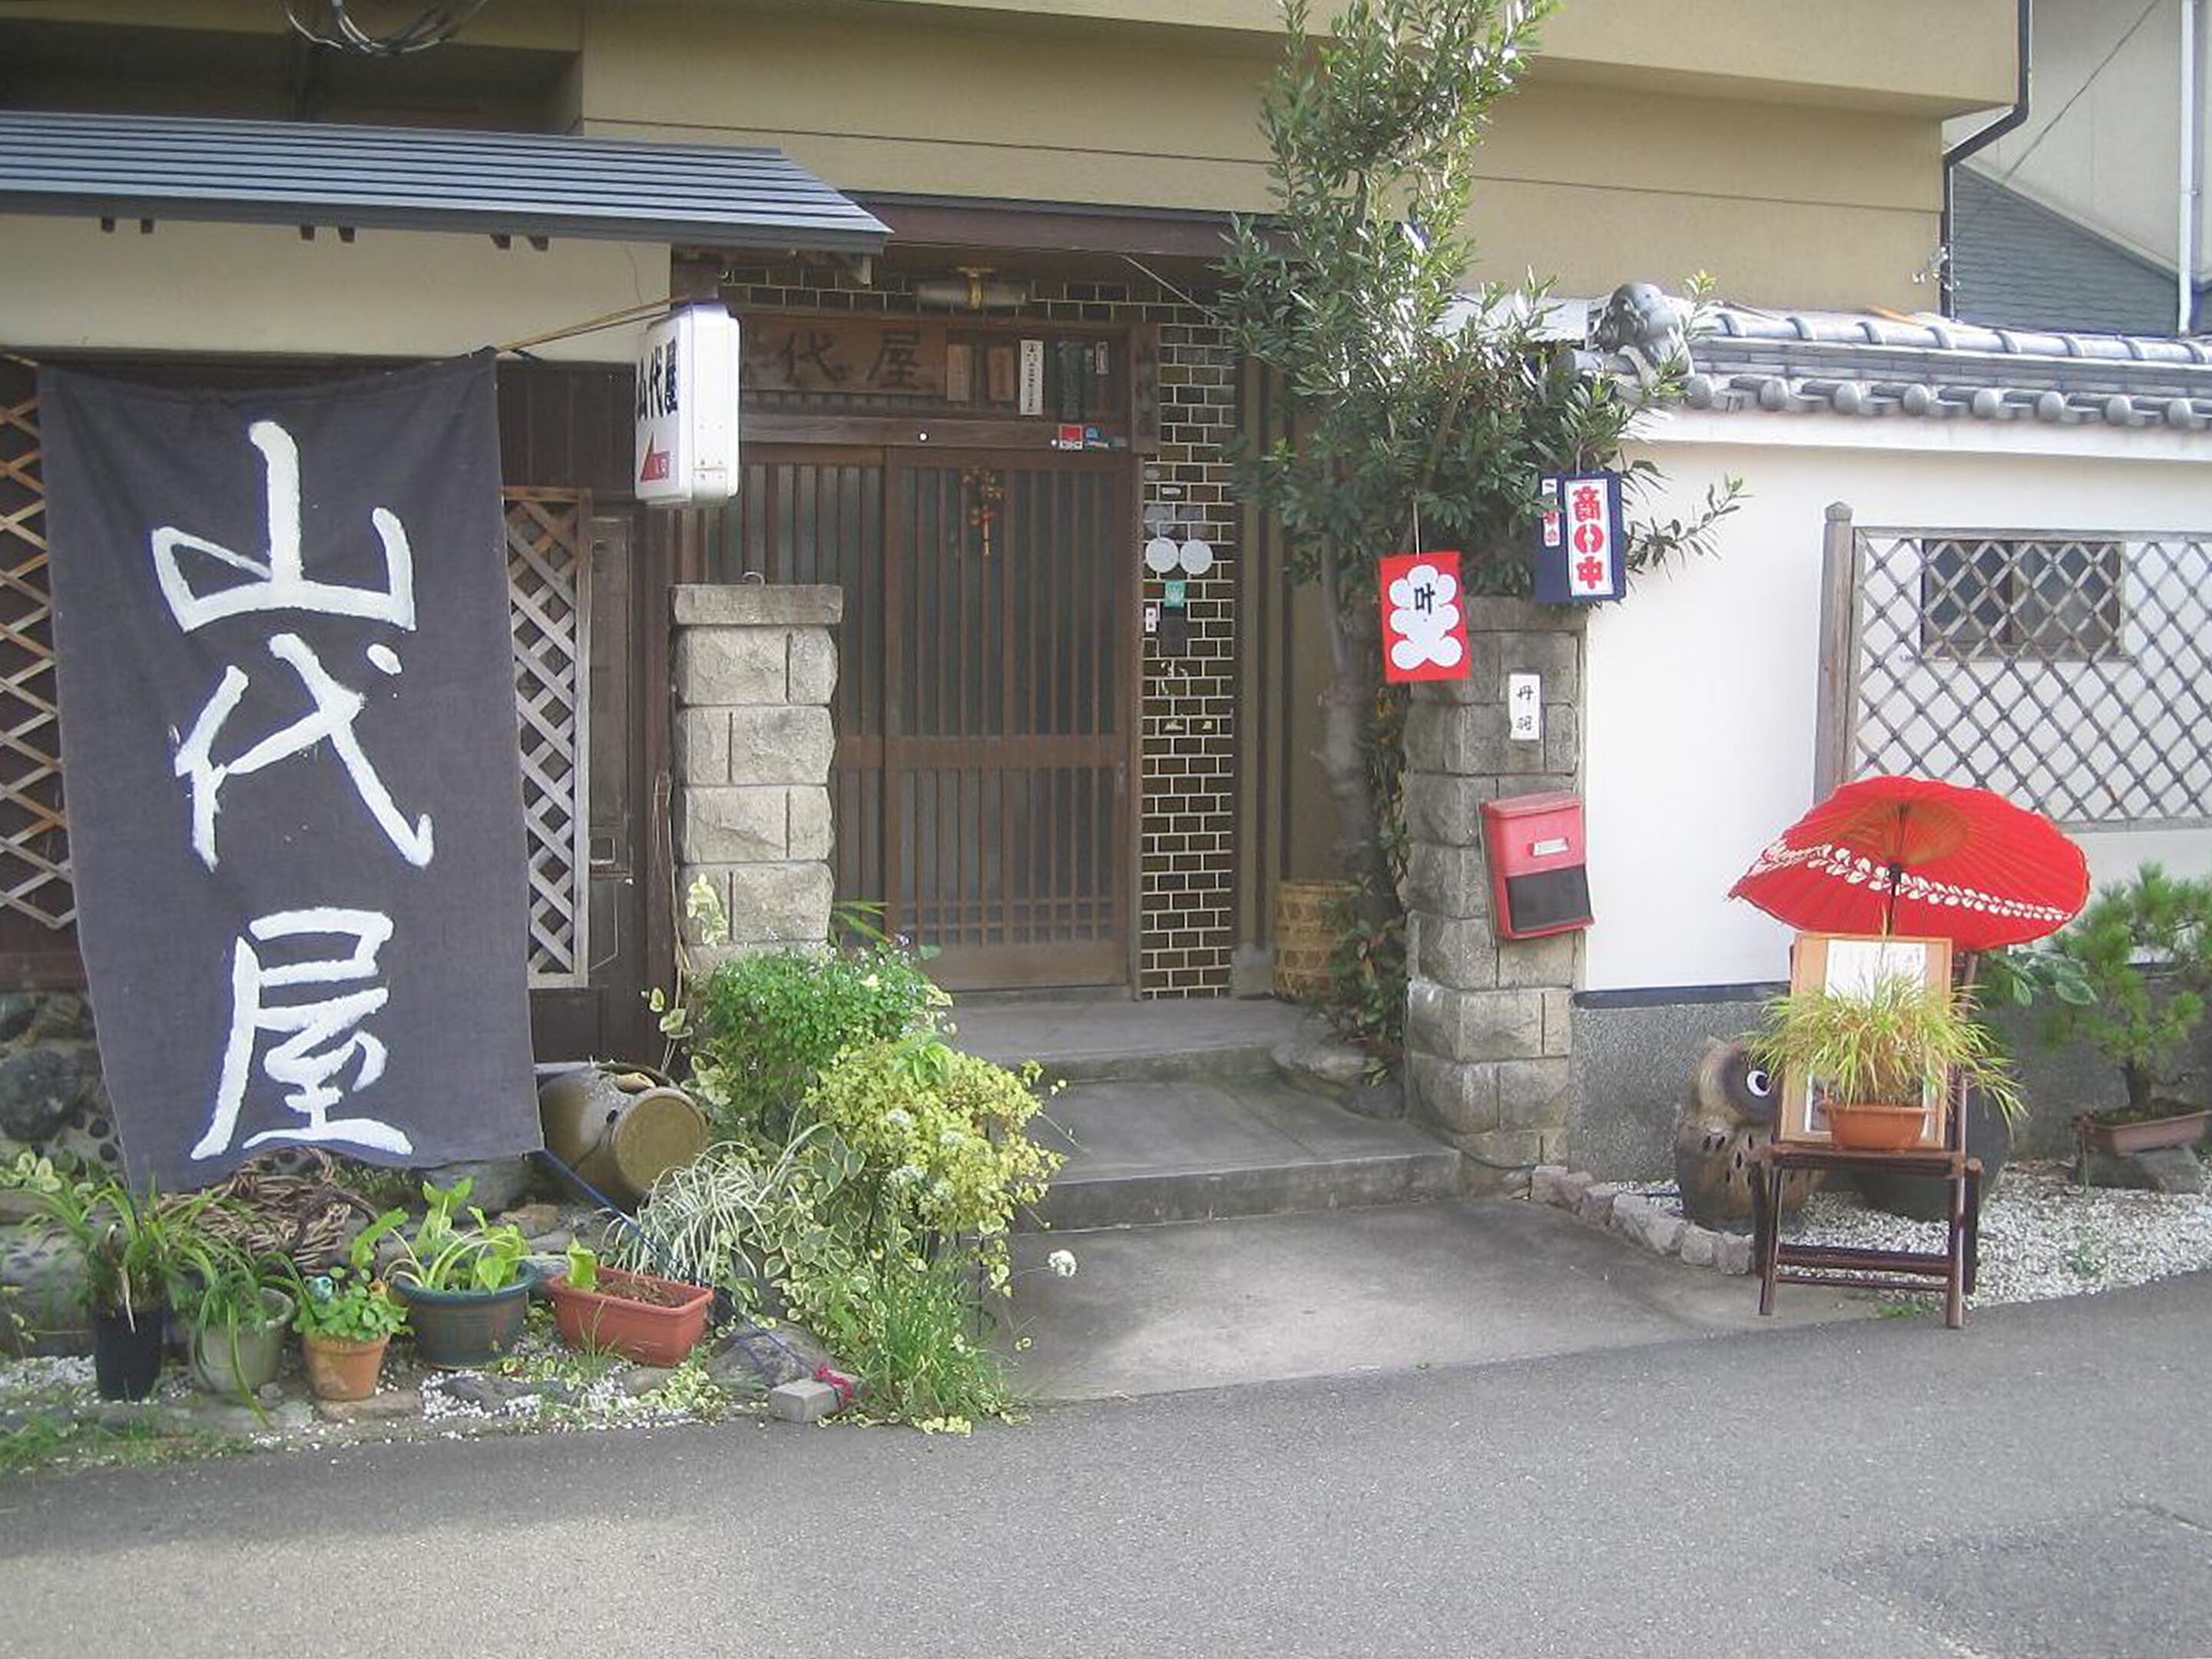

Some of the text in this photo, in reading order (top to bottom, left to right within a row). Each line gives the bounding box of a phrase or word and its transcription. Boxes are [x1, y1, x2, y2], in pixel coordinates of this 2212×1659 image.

[151, 419, 434, 1160] 山代屋
[1413, 582, 1435, 615] 叶
